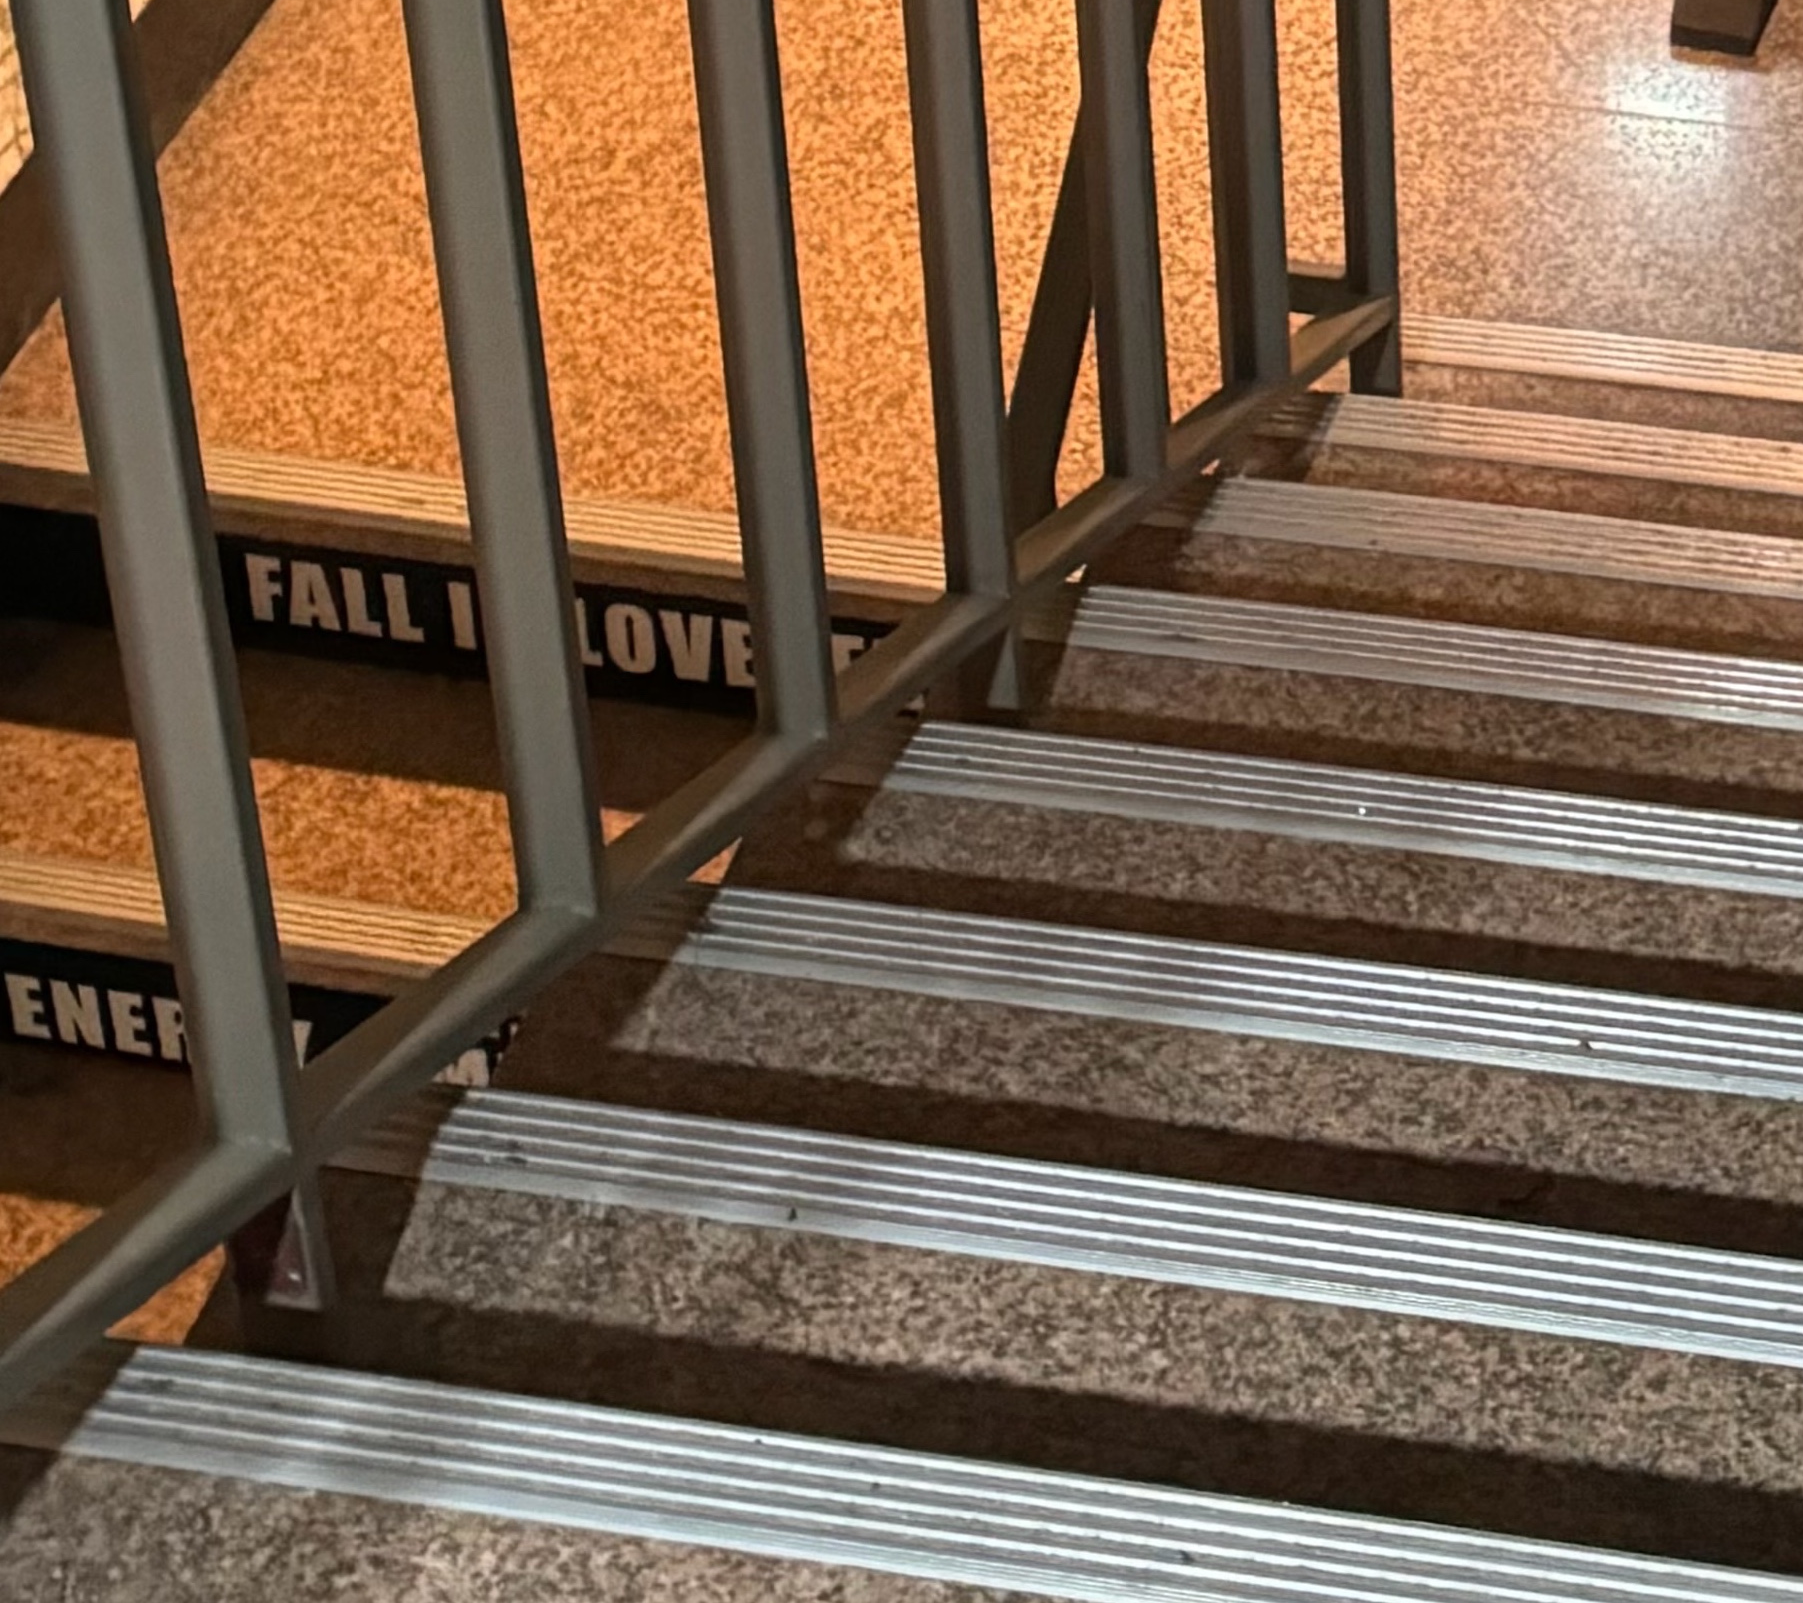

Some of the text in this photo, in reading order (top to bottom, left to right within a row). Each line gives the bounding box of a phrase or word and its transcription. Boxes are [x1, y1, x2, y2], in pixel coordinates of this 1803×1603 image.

[243, 551, 425, 643] FALL
[449, 581, 478, 651] I
[574, 596, 757, 689] LOVE
